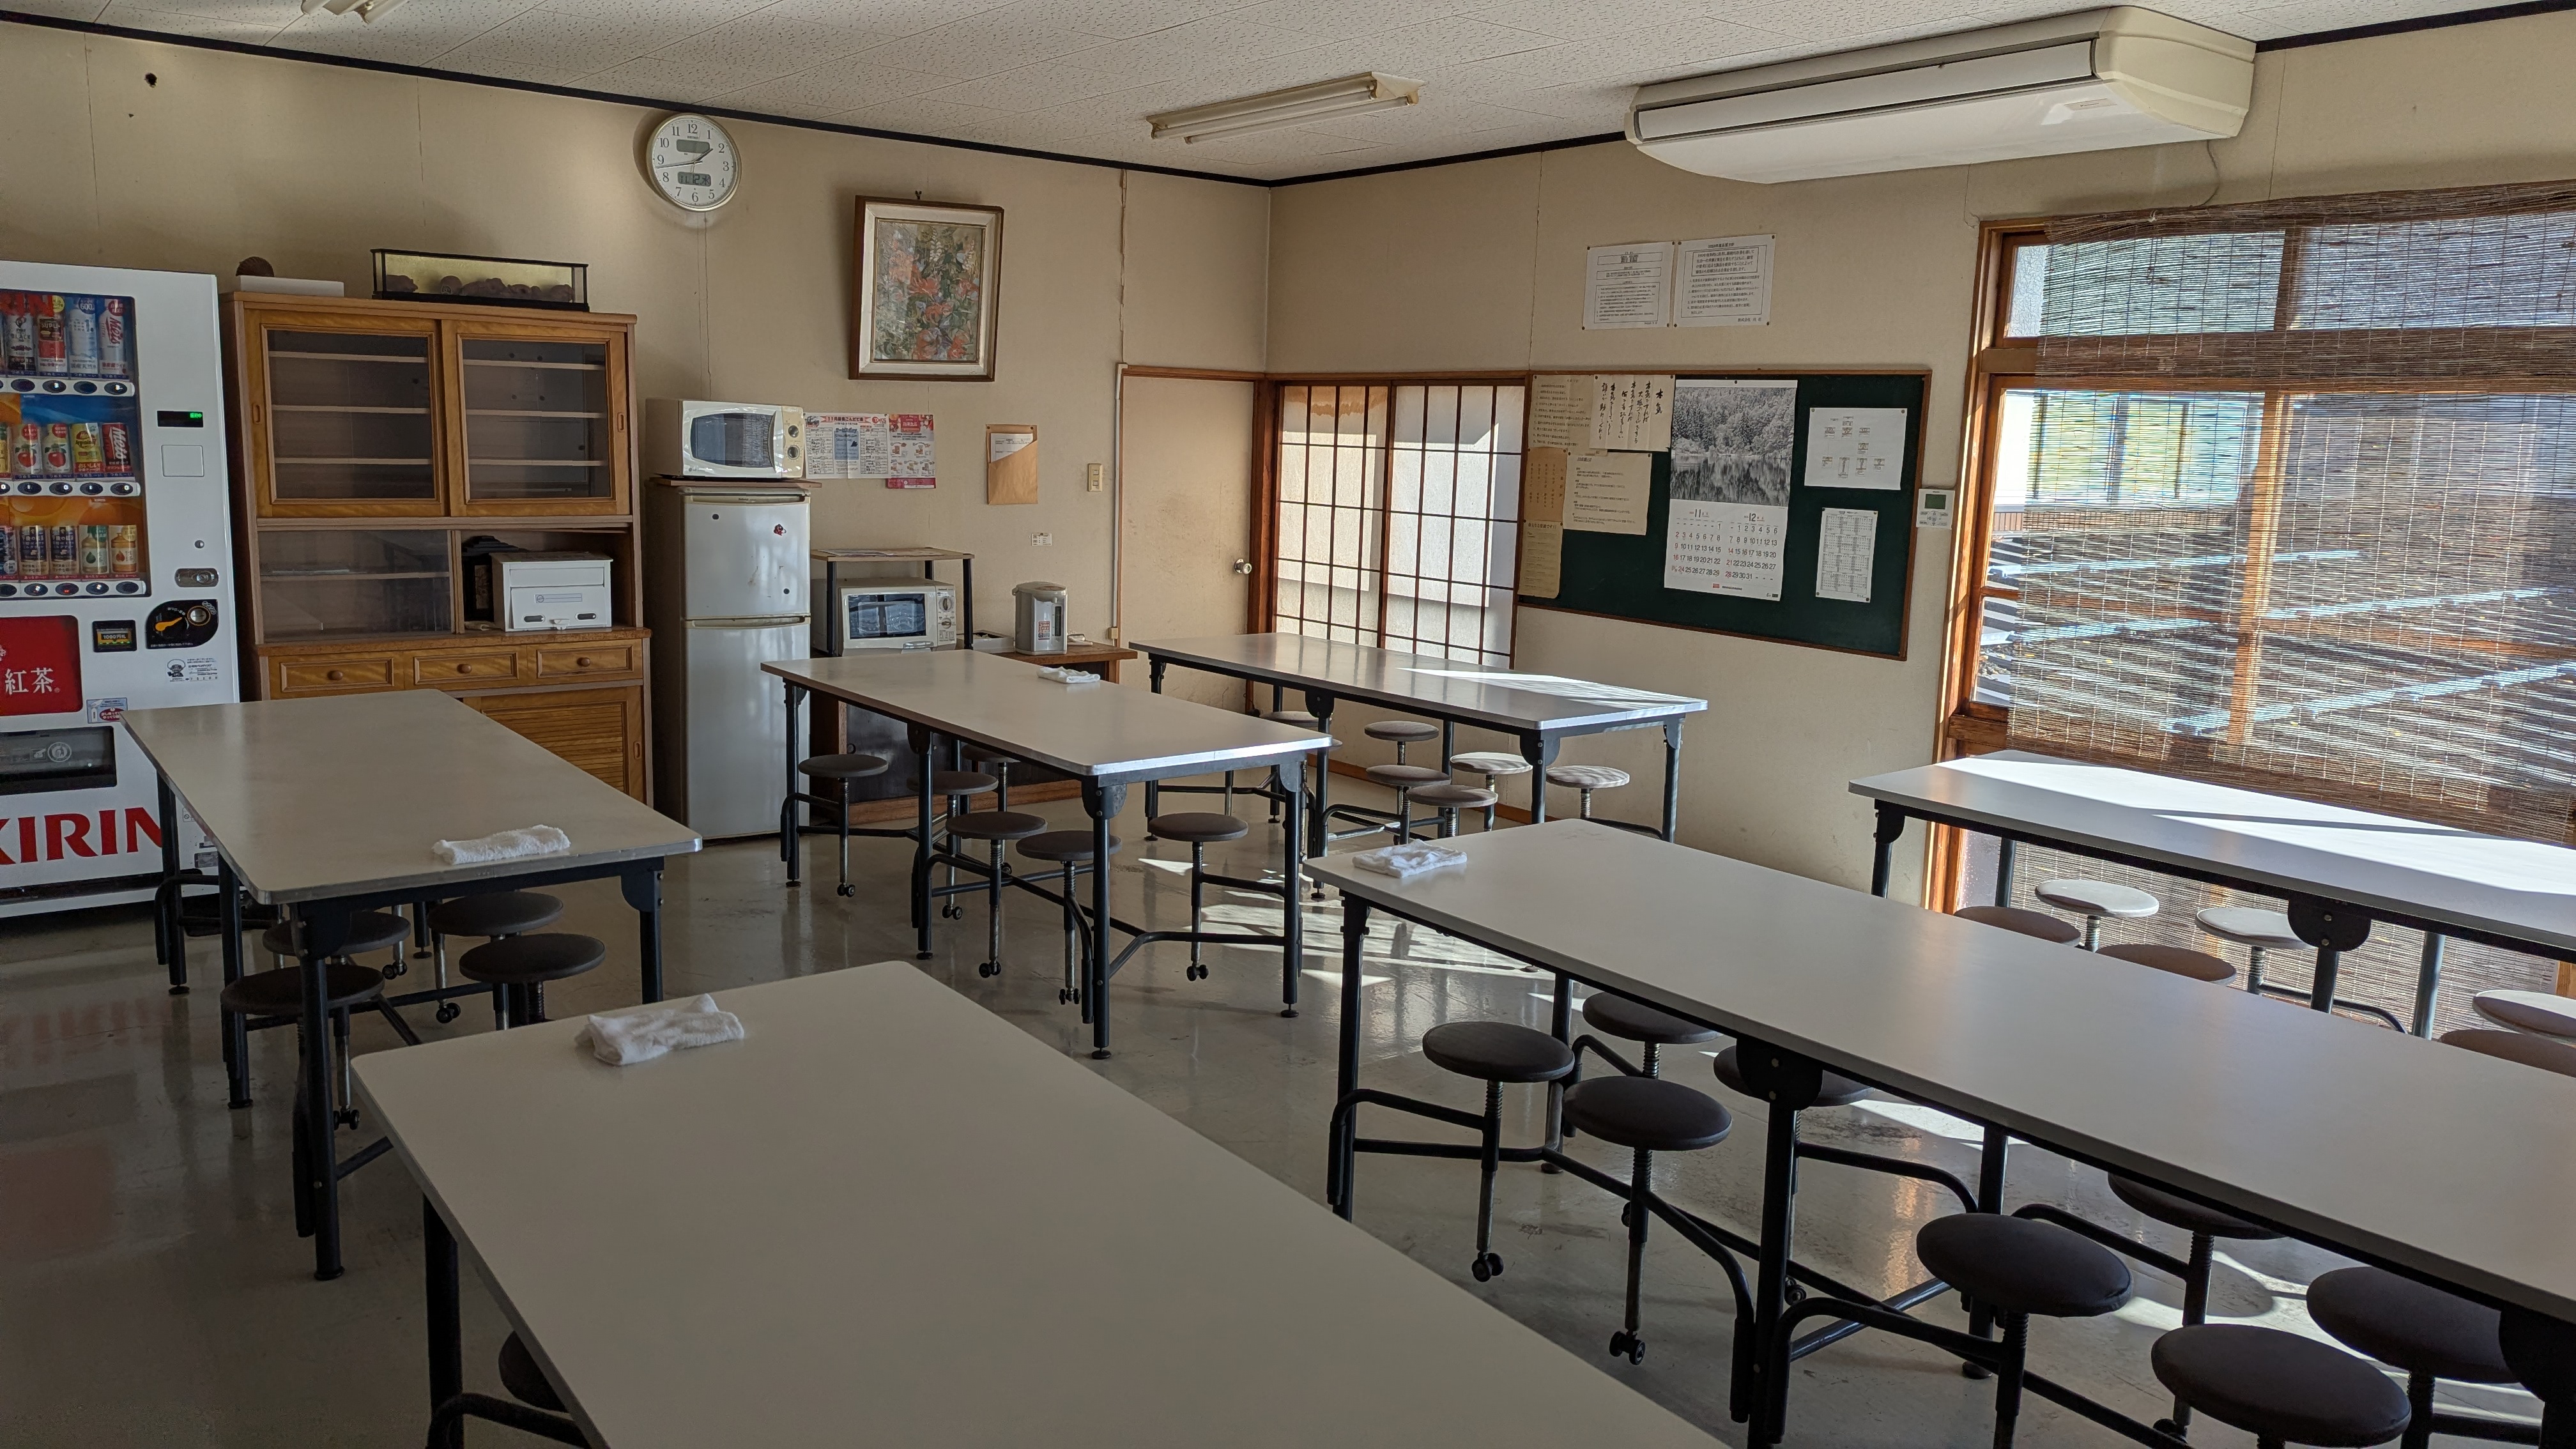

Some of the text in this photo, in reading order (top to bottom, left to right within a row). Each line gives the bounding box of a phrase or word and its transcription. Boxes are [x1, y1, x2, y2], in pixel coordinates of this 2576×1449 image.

[671, 126, 680, 136] 11
[687, 123, 698, 134] 12
[707, 130, 712, 139] 1
[660, 137, 670, 148] 10
[718, 143, 725, 153] 2
[657, 155, 664, 165] 9
[723, 161, 730, 171] 3
[663, 172, 670, 183] 8
[719, 178, 726, 188] 4
[675, 187, 682, 197] 7
[708, 189, 715, 199] 5
[691, 192, 699, 203] 6
[1655, 388, 1664, 415] 本気
[1695, 509, 1701, 518] 11
[1749, 513, 1756, 522] 12
[5, 667, 54, 695] 紅茶
